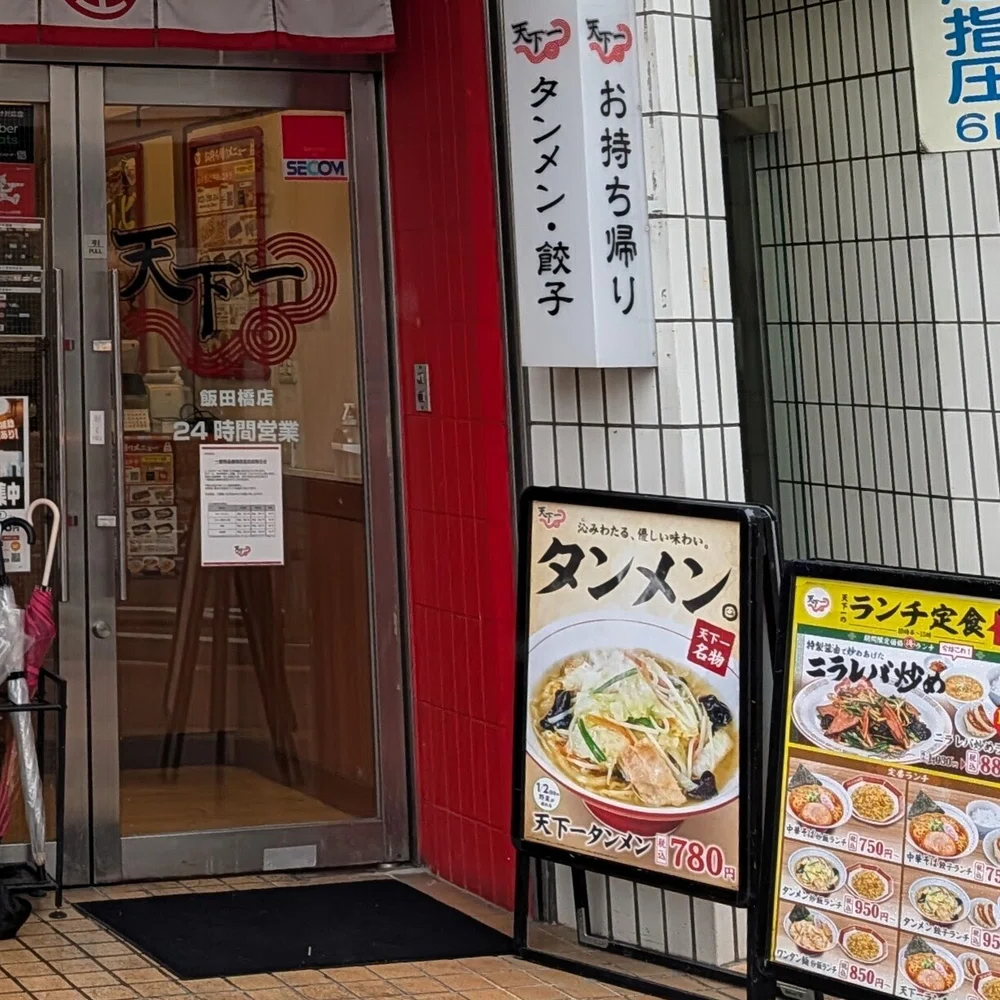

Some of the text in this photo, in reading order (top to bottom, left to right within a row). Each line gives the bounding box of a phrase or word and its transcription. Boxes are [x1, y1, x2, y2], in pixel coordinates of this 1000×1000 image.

[511, 20, 563, 54] 天下一
[585, 18, 627, 55] 天下一
[956, 112, 1000, 143] 6
[286, 160, 345, 176] SECOM
[530, 76, 574, 316] タンメン・餃子
[600, 79, 638, 315] お持ち帰り
[111, 222, 306, 343] 天下一
[200, 389, 274, 407] 飯田橋店
[173, 420, 300, 443] 24時間営業
[538, 506, 562, 524] 天下一
[536, 537, 733, 613] タンメン
[849, 595, 987, 639] ランチ定食
[692, 643, 725, 668] 名物
[697, 628, 730, 647] 天下一
[805, 656, 946, 695] ニラレバ炒め
[533, 813, 652, 856] 天下一タンメン
[670, 838, 736, 881] 780円
